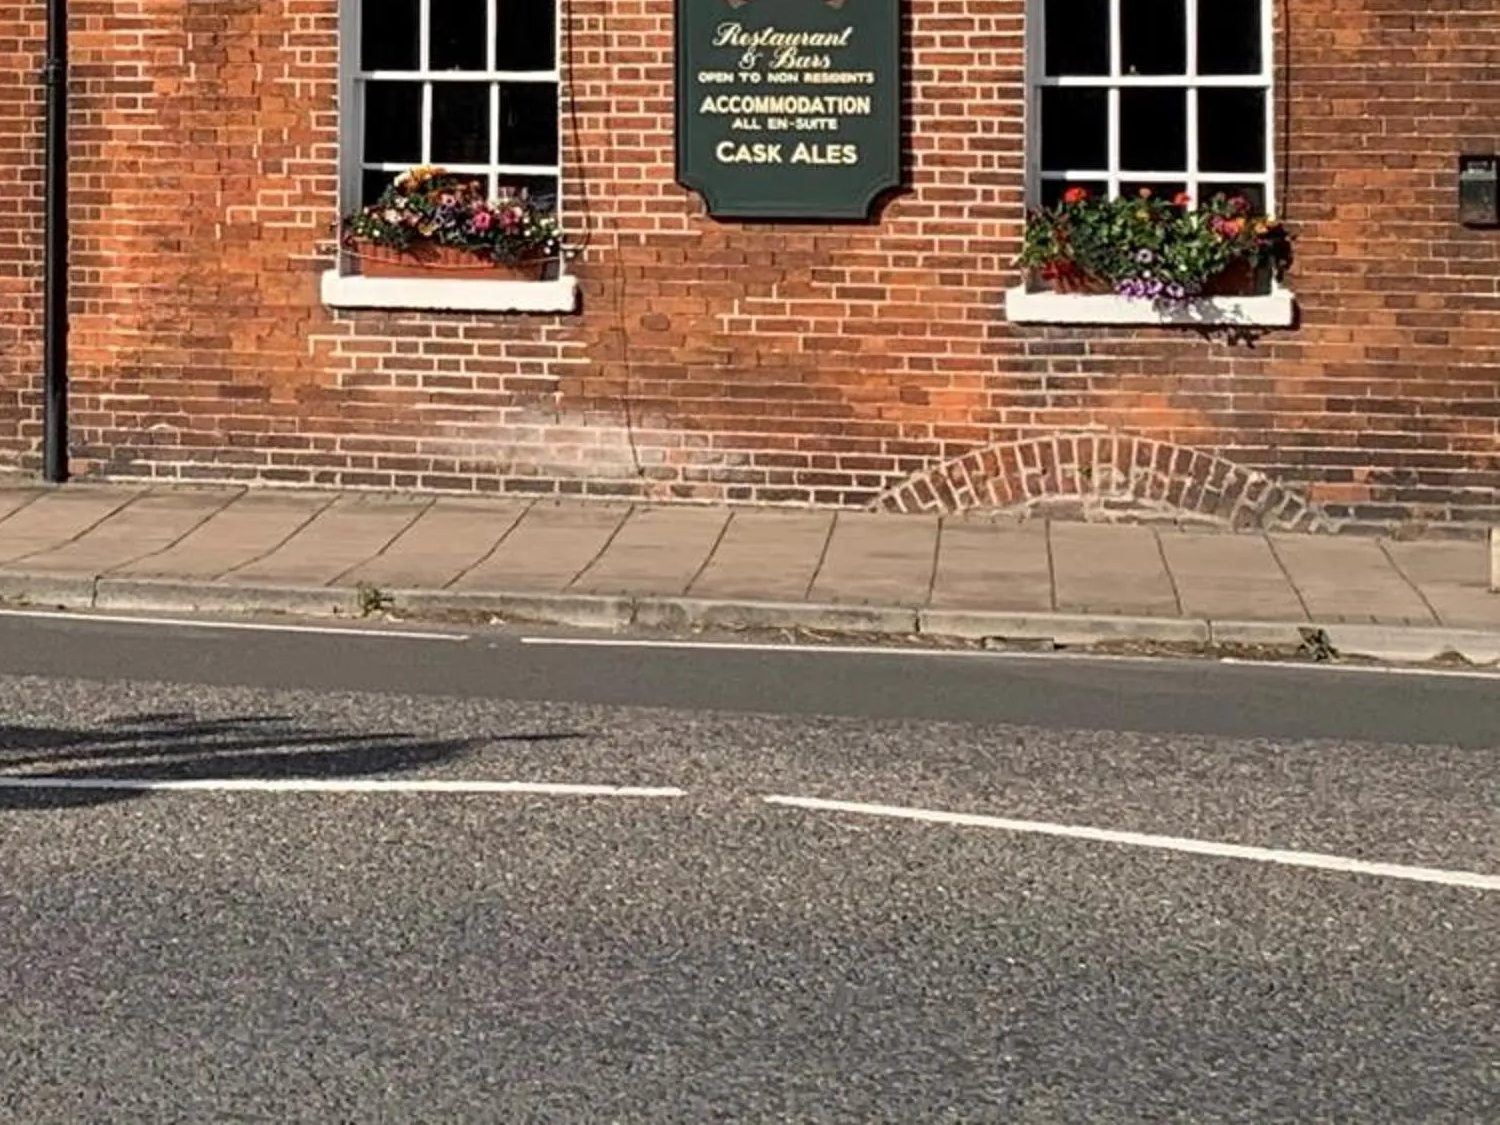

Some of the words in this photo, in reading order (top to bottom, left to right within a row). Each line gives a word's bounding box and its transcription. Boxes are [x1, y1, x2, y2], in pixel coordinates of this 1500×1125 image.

[712, 22, 854, 48] Restaurant
[737, 46, 764, 70] &
[769, 47, 832, 69] Bars
[697, 71, 735, 84] OPEN
[738, 71, 761, 84] TO
[767, 71, 800, 84] NON
[803, 71, 876, 84] RESIDENTS
[699, 95, 871, 115] ACCOMMODATION
[731, 118, 762, 130] ALL
[767, 118, 839, 130] EN-SUITE
[715, 141, 784, 164] CASK
[790, 142, 859, 165] ALES
